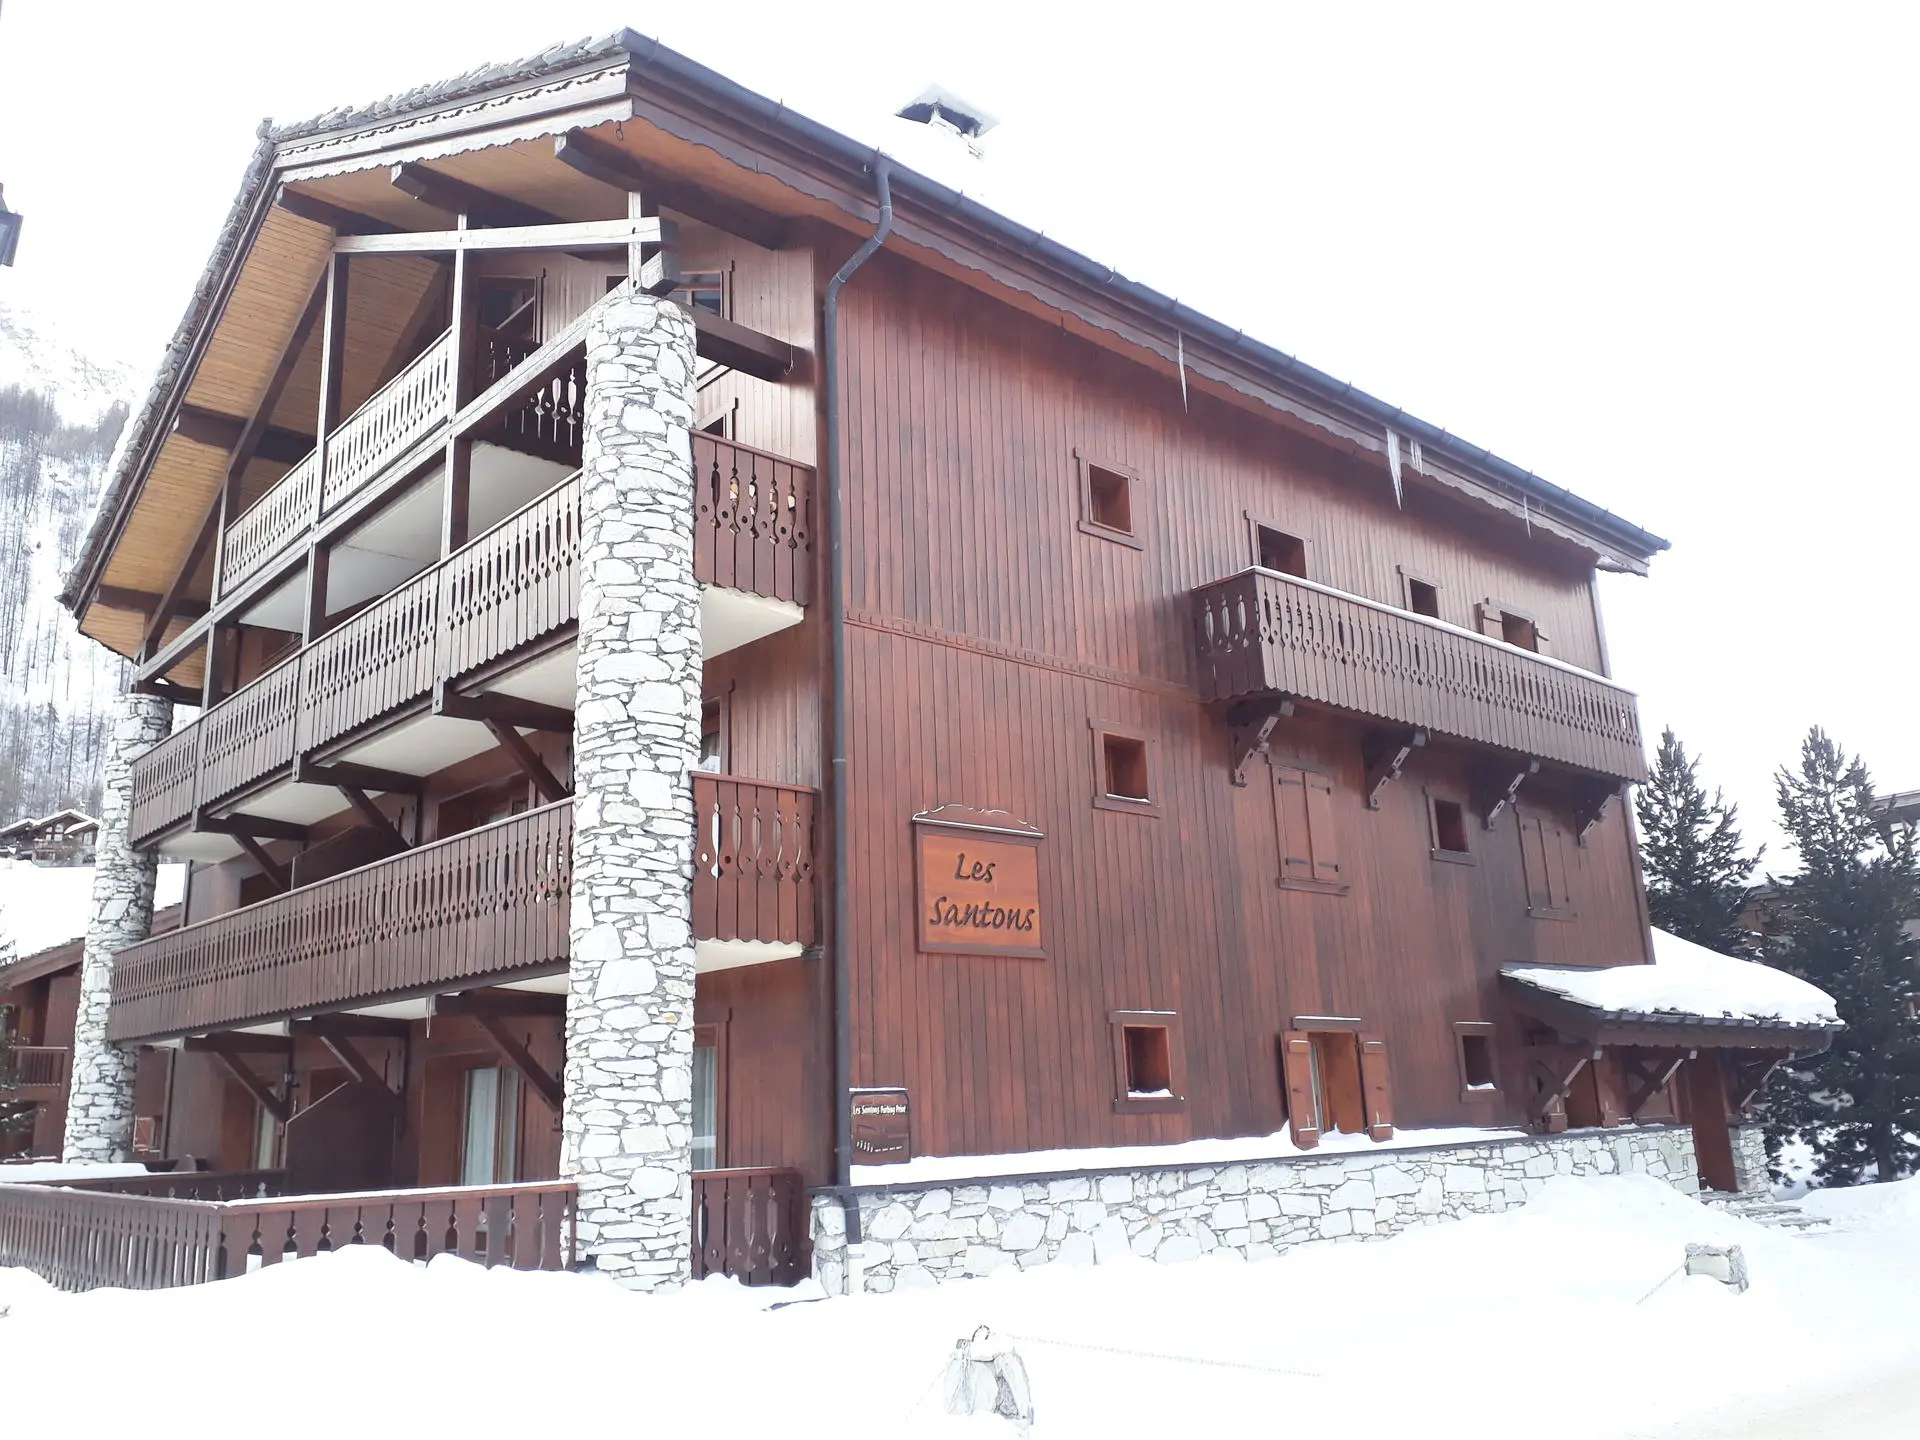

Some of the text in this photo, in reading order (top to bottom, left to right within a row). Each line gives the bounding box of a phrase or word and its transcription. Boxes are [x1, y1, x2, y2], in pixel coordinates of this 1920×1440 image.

[954, 853, 996, 883] Les
[929, 896, 1035, 931] Santons
[852, 1104, 861, 1115] Les
